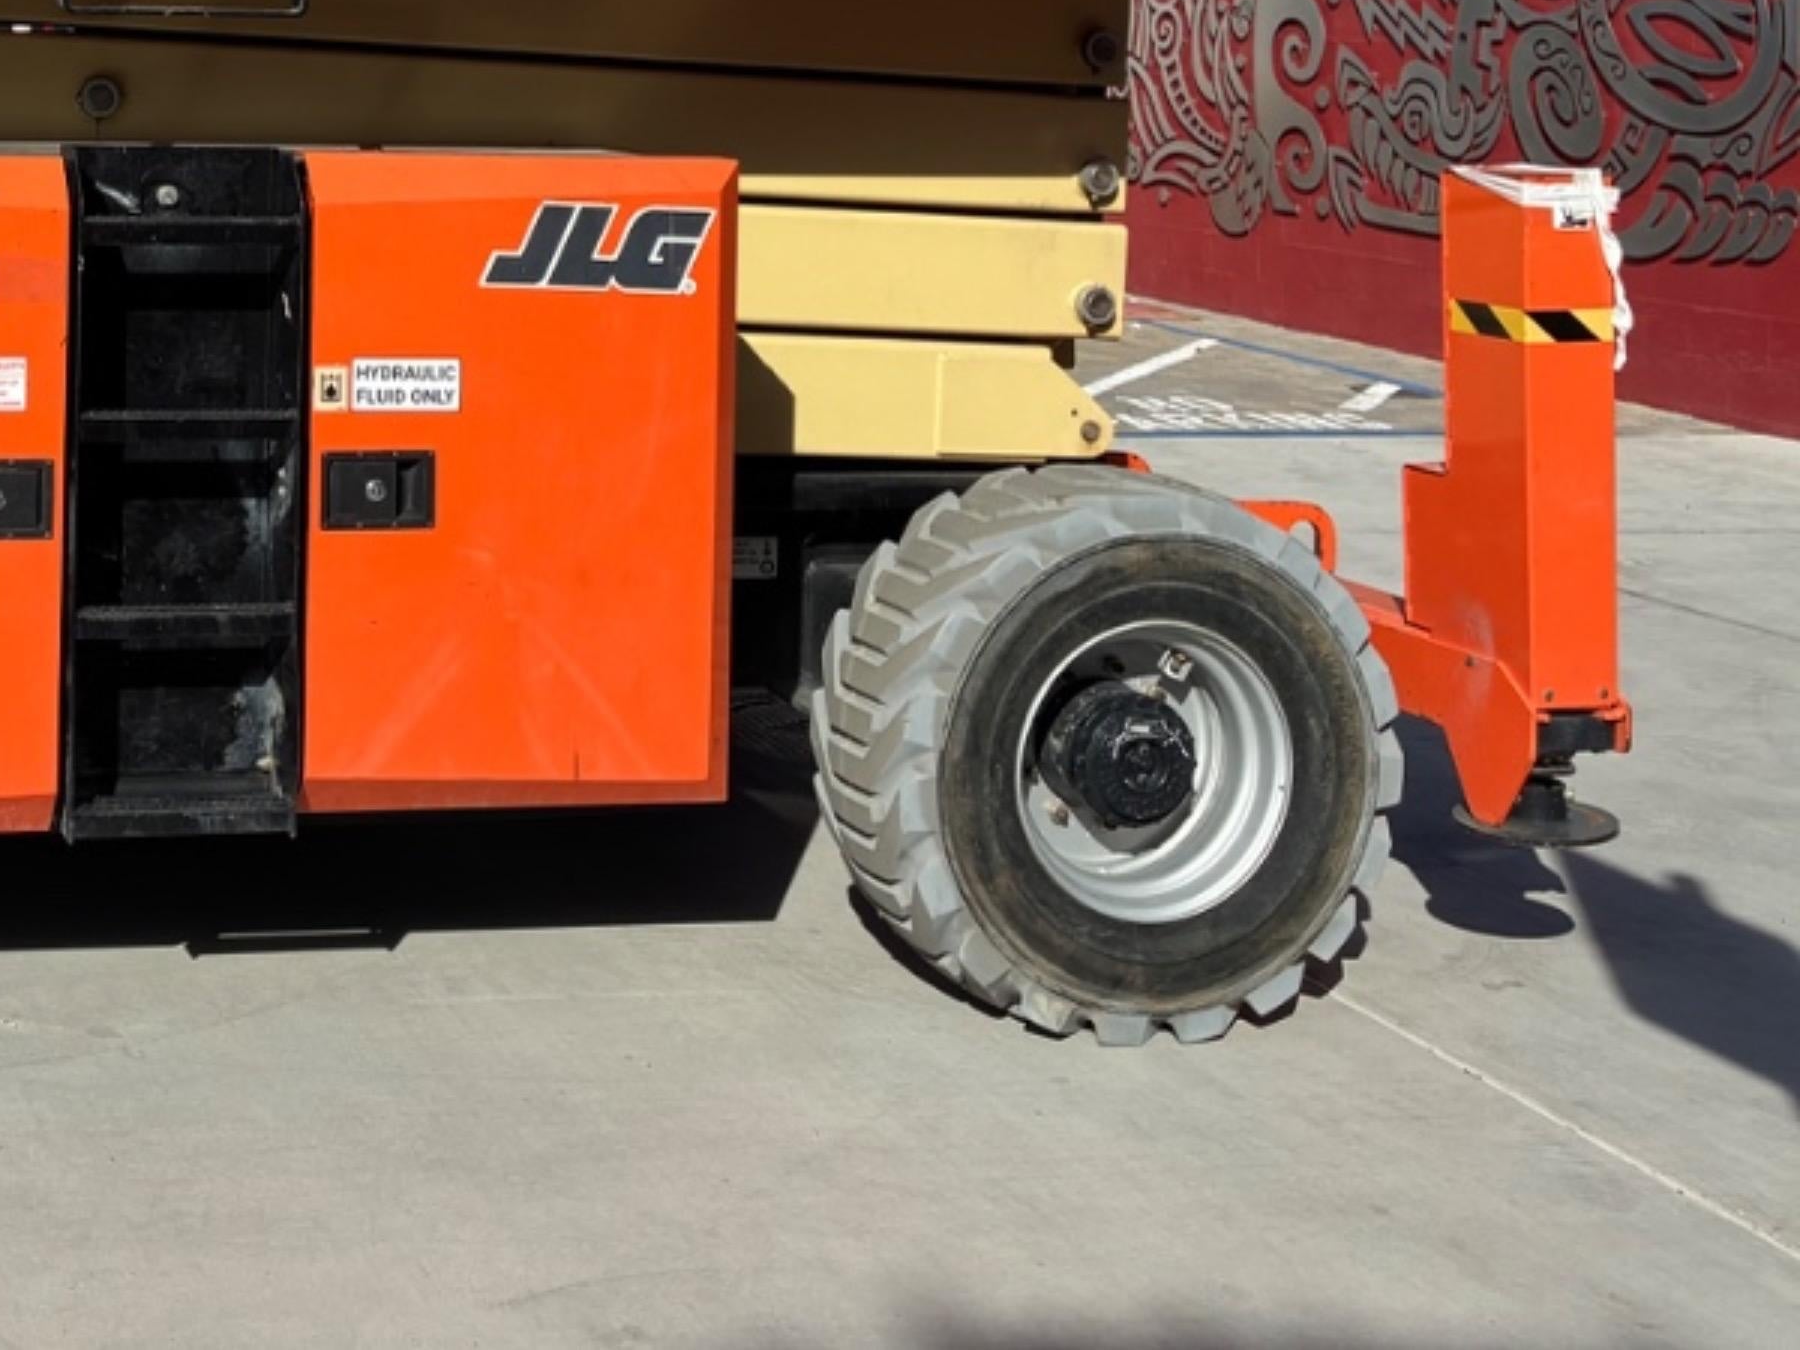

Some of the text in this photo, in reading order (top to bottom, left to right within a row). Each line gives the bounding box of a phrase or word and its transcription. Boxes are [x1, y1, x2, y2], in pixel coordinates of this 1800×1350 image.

[479, 200, 716, 295] JLG
[355, 365, 457, 381] HYDRAULIC
[355, 388, 455, 405] FLUID ONLY
